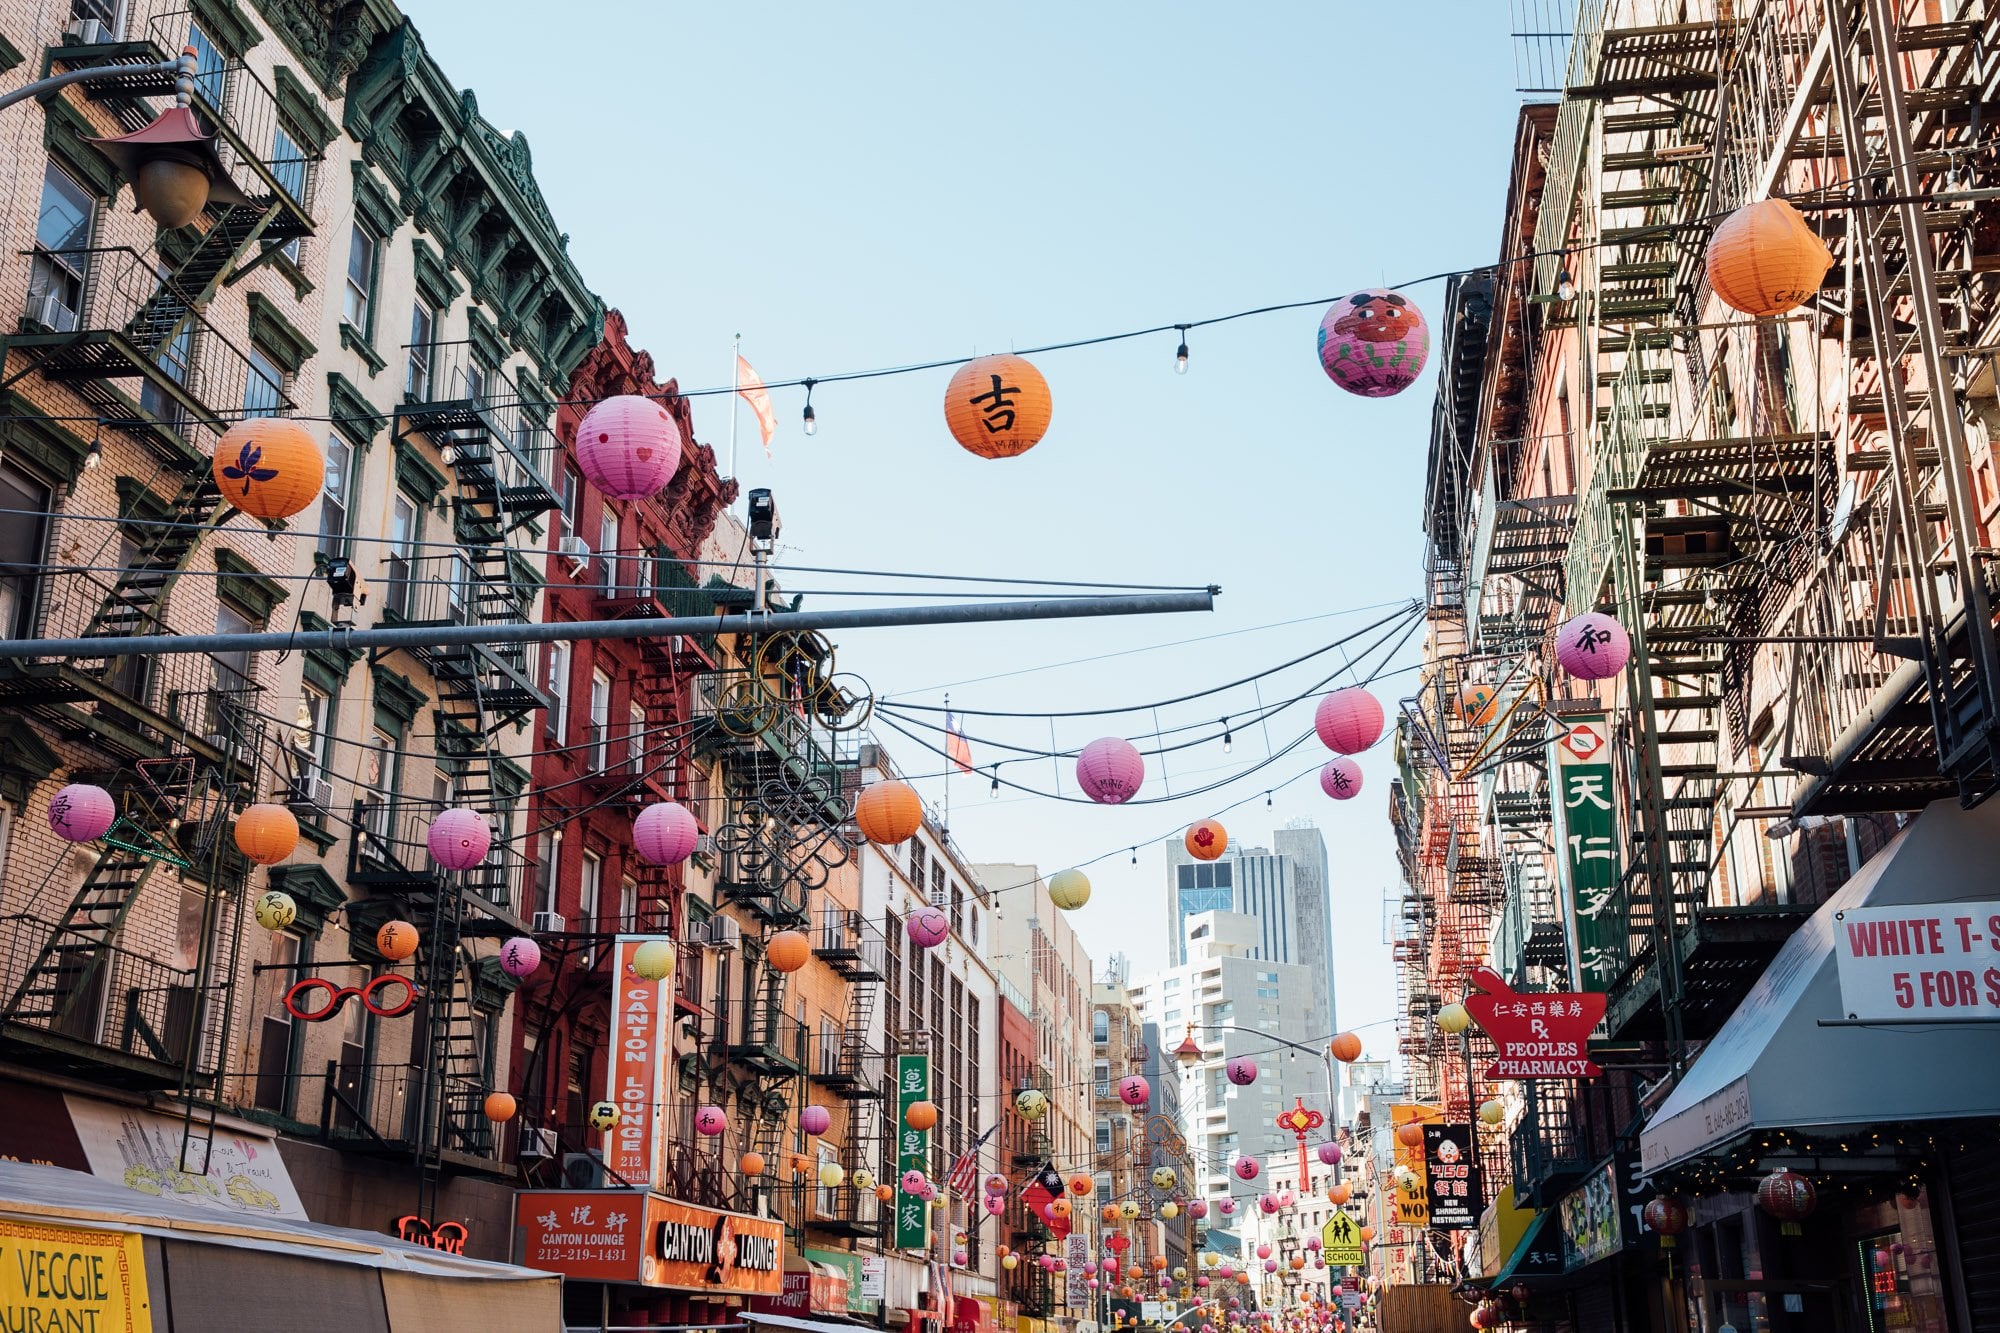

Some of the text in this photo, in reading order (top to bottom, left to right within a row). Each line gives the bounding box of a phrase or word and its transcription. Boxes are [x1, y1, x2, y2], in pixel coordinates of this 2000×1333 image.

[969, 374, 1022, 433] 吉
[1575, 624, 1612, 654] 和
[1332, 768, 1352, 790] 春
[1847, 918, 1944, 957] WHITE
[506, 944, 524, 970] 春
[1893, 972, 1914, 1008] 5
[1920, 970, 1978, 1007] FOR
[1492, 1000, 1583, 1017] 仁安西藥房
[1506, 1042, 1578, 1056] PEOPLES
[621, 989, 649, 1152] CANTON LOUNGE
[1235, 1065, 1250, 1081] 春
[1498, 1060, 1588, 1075] PHARMACY
[1127, 1082, 1141, 1099] 吉
[700, 1113, 716, 1128] 和
[620, 1156, 641, 1167] 212
[1242, 1160, 1253, 1173] 吉
[856, 1173, 865, 1184] 吉
[1431, 1165, 1469, 1178] 456
[906, 1176, 919, 1184] 和
[1403, 1178, 1413, 1189] 吉
[1434, 1180, 1468, 1196] 餐館
[1053, 1205, 1064, 1213] 和
[542, 1234, 625, 1246] CANTON LOUNGE
[664, 1221, 779, 1271] CANTON LOUNGE
[537, 1248, 627, 1261] 212-219-1431
[1327, 1252, 1361, 1262] SCHOOL
[1530, 1252, 1558, 1264] 天仁
[17, 1249, 108, 1301] VEGGIE
